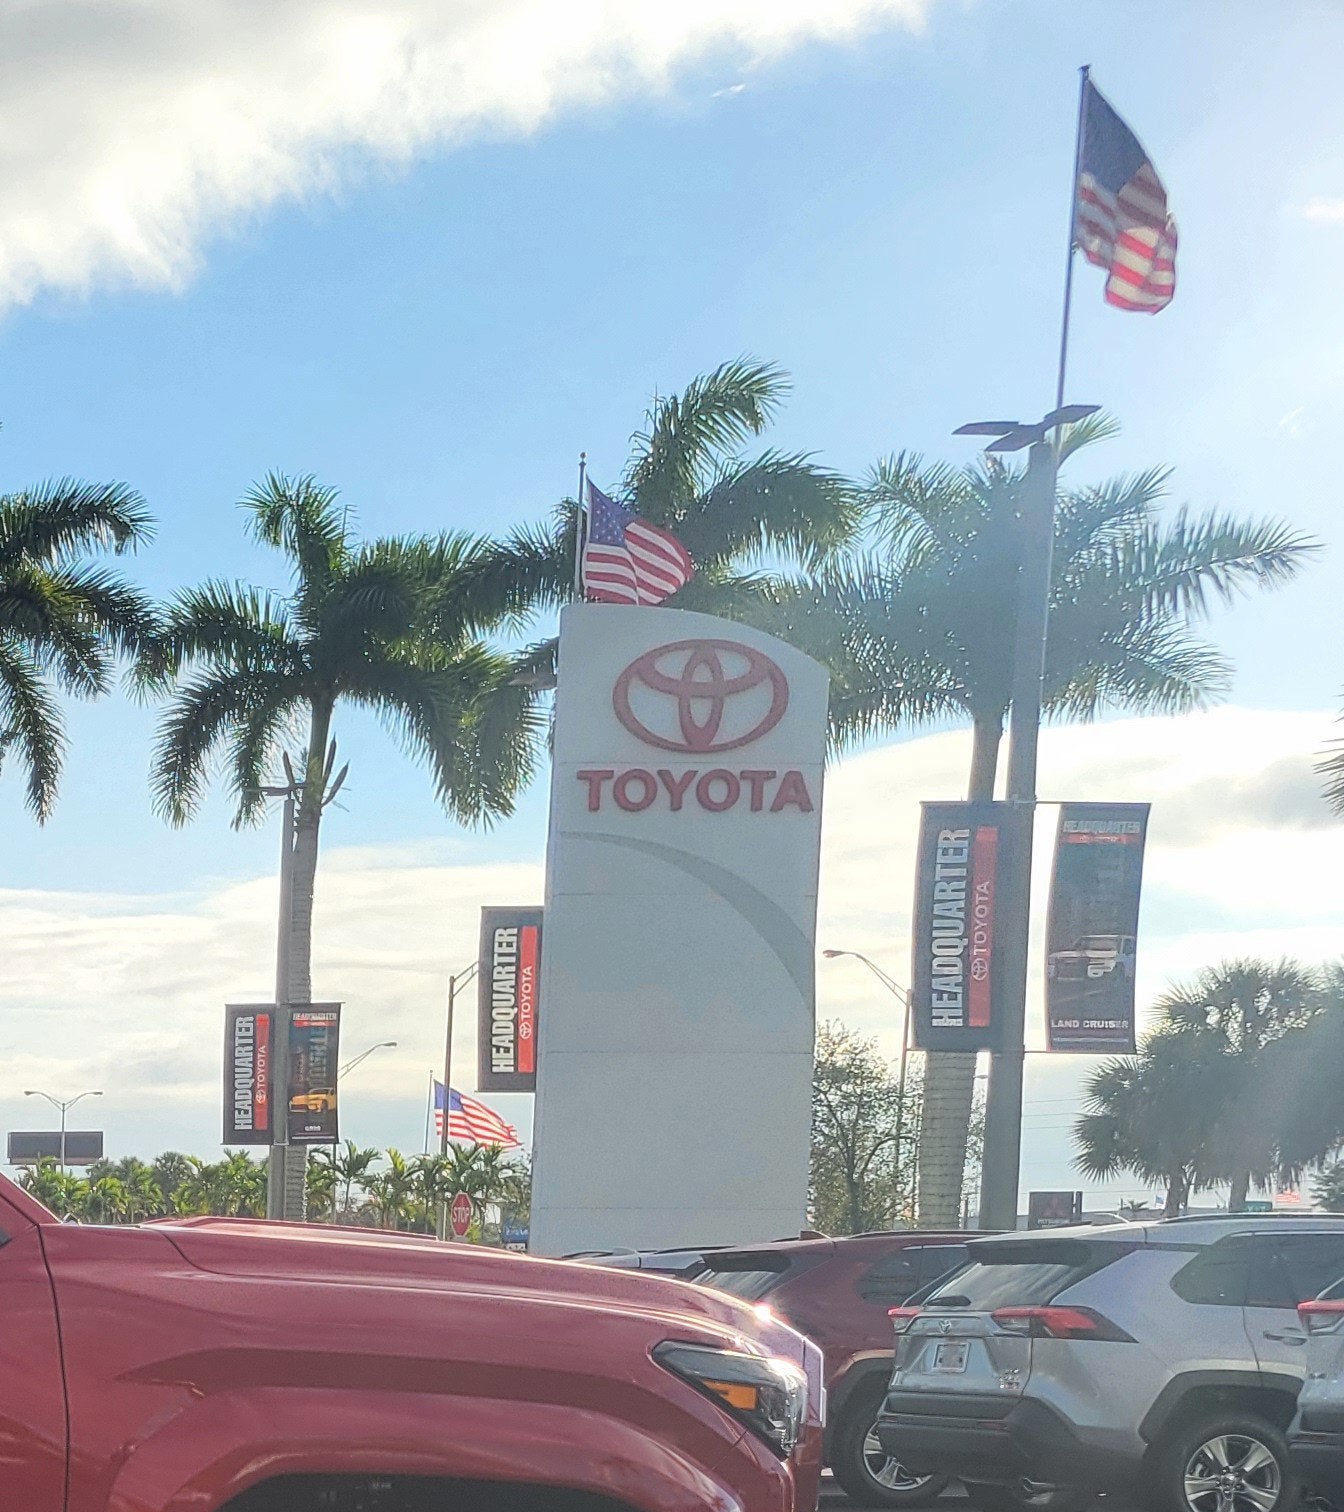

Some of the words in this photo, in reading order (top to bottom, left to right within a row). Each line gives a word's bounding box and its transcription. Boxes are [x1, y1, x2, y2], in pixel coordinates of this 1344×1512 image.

[576, 768, 814, 813] TOYOTA
[931, 828, 971, 1027] HEADQUARTER
[972, 880, 990, 956] TOYOTA
[492, 927, 518, 1074] HEADQUARTER
[520, 965, 532, 1020] TOYOTA
[1051, 1019, 1080, 1029] LAND
[234, 1016, 255, 1130] HEADQUARTER
[257, 1046, 267, 1088] TOYOTA
[452, 1206, 470, 1224] STOP
